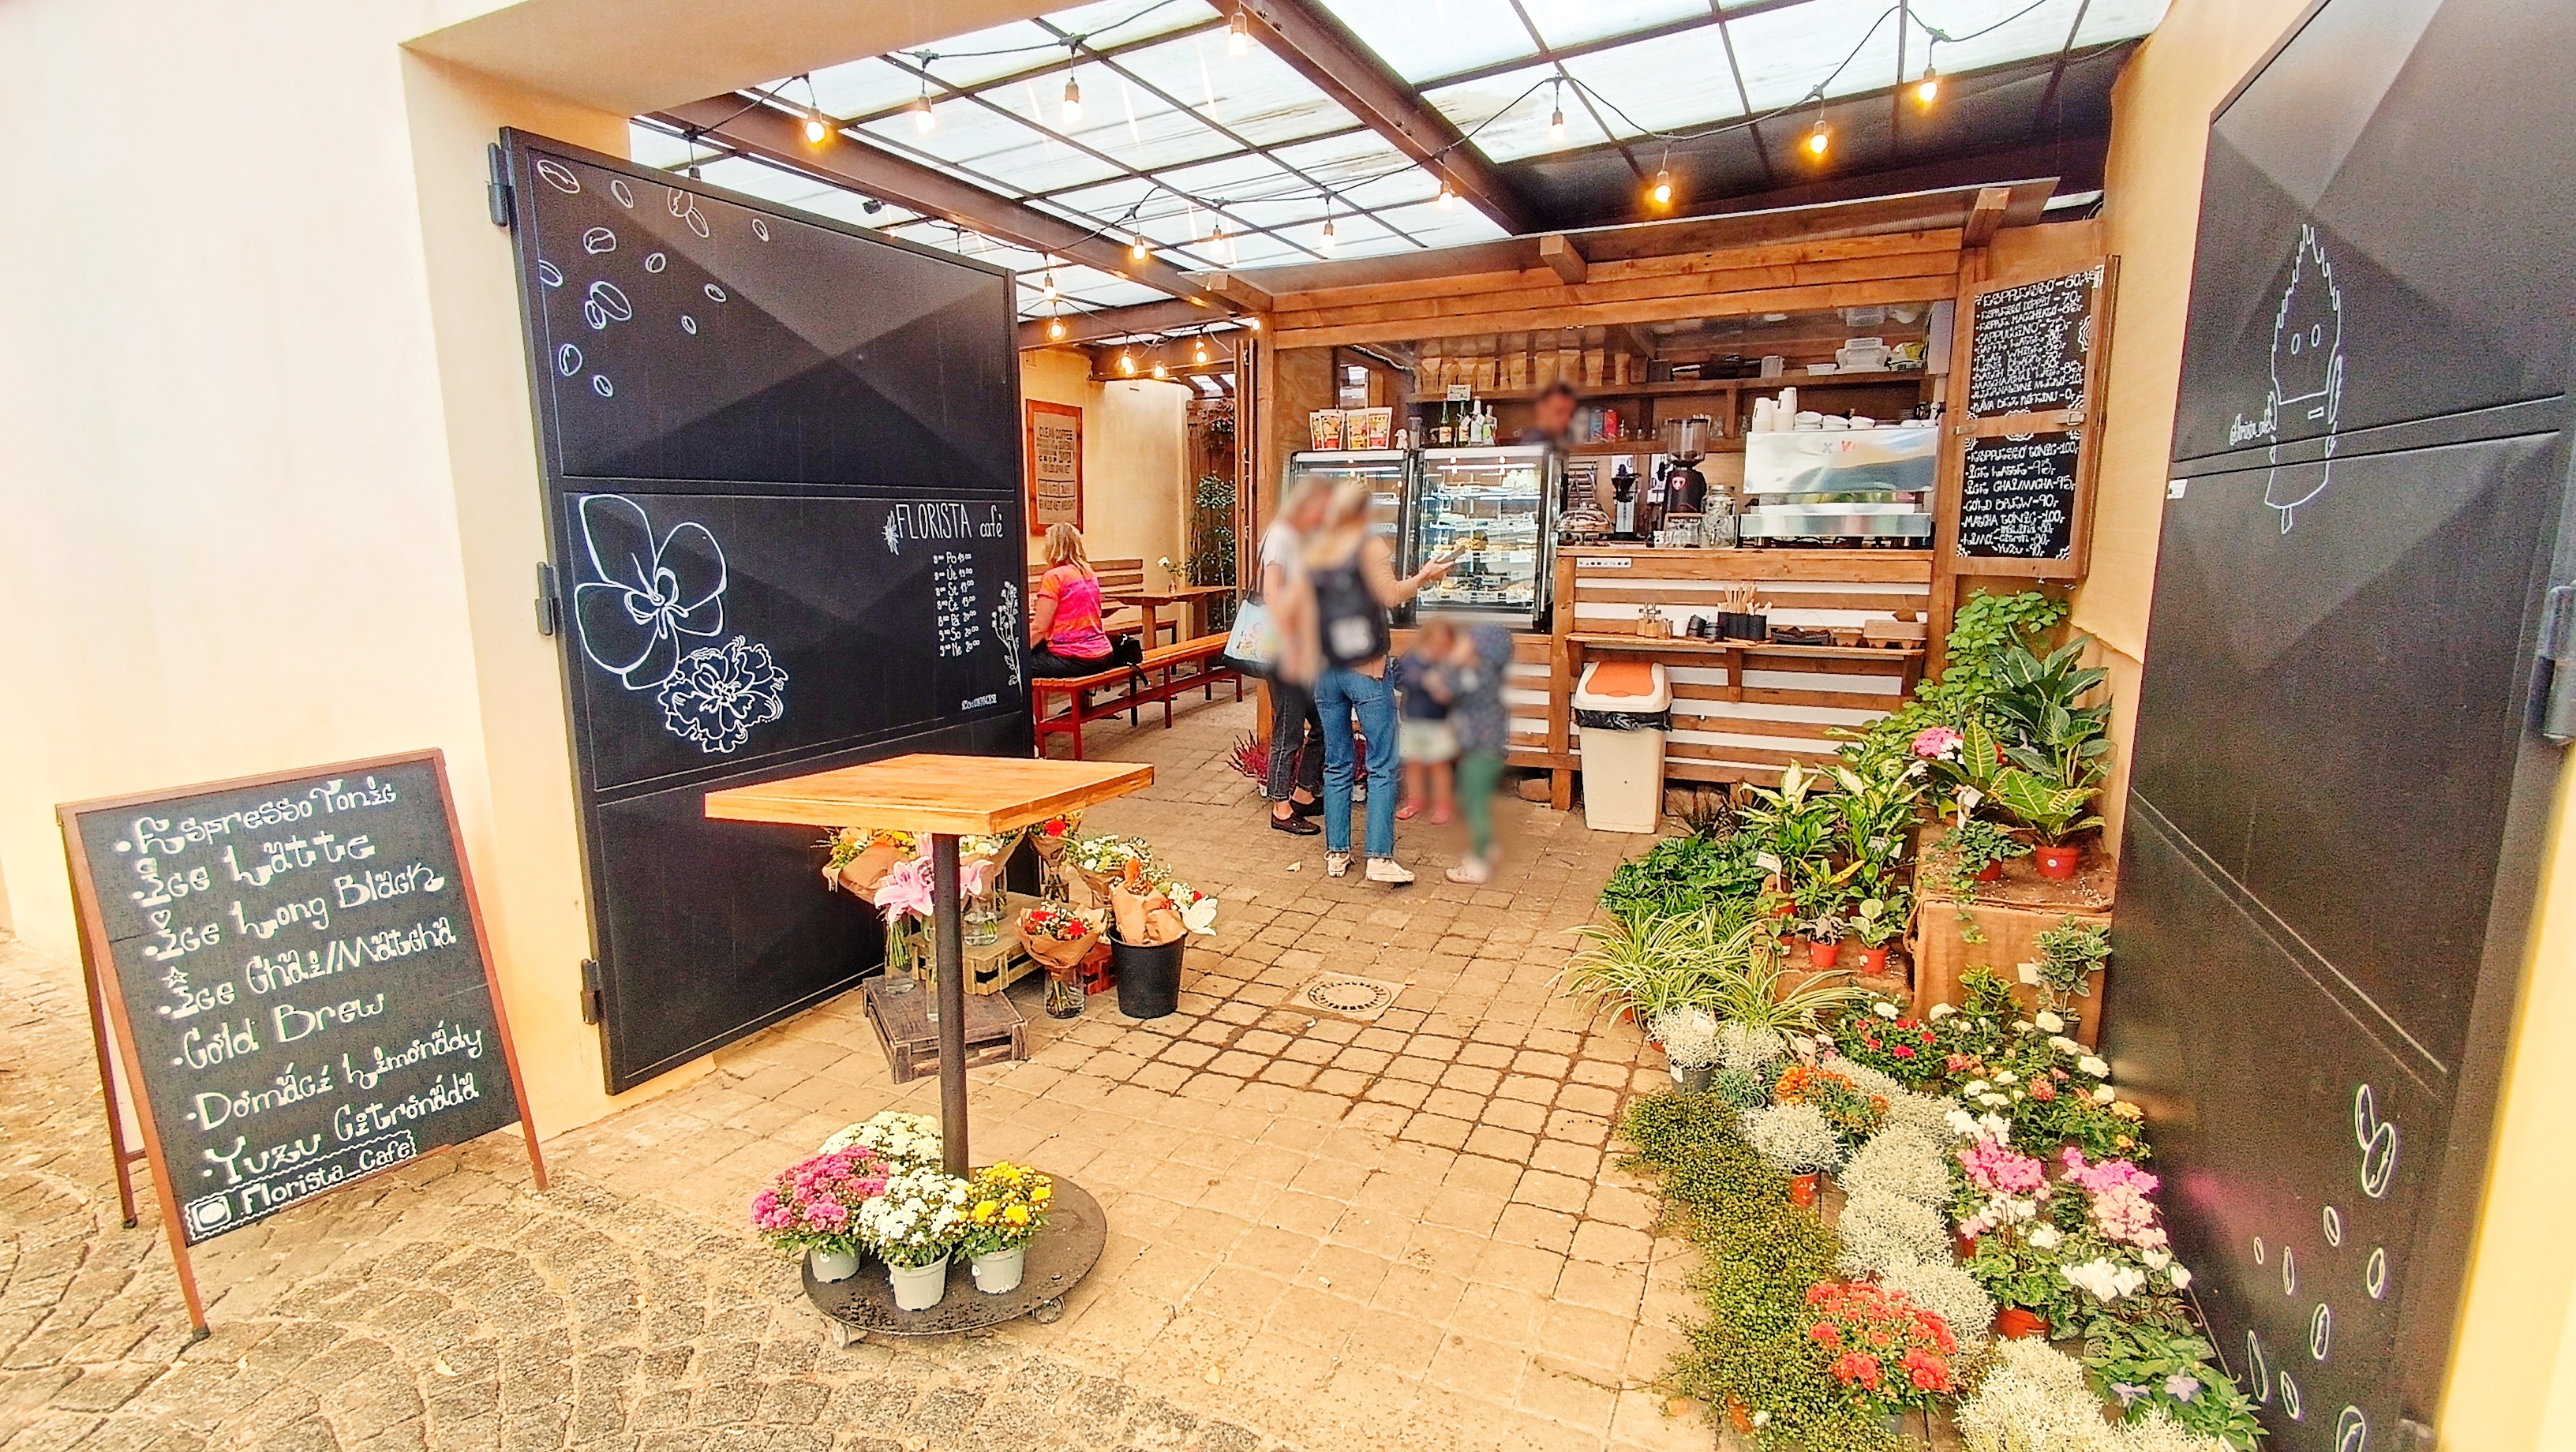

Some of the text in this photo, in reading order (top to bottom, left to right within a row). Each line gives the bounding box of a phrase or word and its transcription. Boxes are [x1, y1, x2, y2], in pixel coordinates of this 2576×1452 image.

[1983, 280, 2054, 307] ESPRESSO
[1970, 444, 2027, 462] ESPRESSO
[896, 503, 972, 538] FLORISTA
[946, 551, 957, 564] Po
[946, 563, 958, 581] Út
[948, 581, 959, 597] St
[948, 597, 959, 612] Čt
[951, 613, 960, 627] Pá
[950, 627, 961, 641] So
[952, 642, 962, 657] Ne
[134, 776, 396, 855] Espresso Tonic
[141, 858, 211, 908] Ice
[150, 863, 445, 960] Ice Long Black
[164, 972, 235, 1018] Ice
[184, 994, 385, 1068] Cold Brew
[204, 1134, 321, 1183] Yuzu
